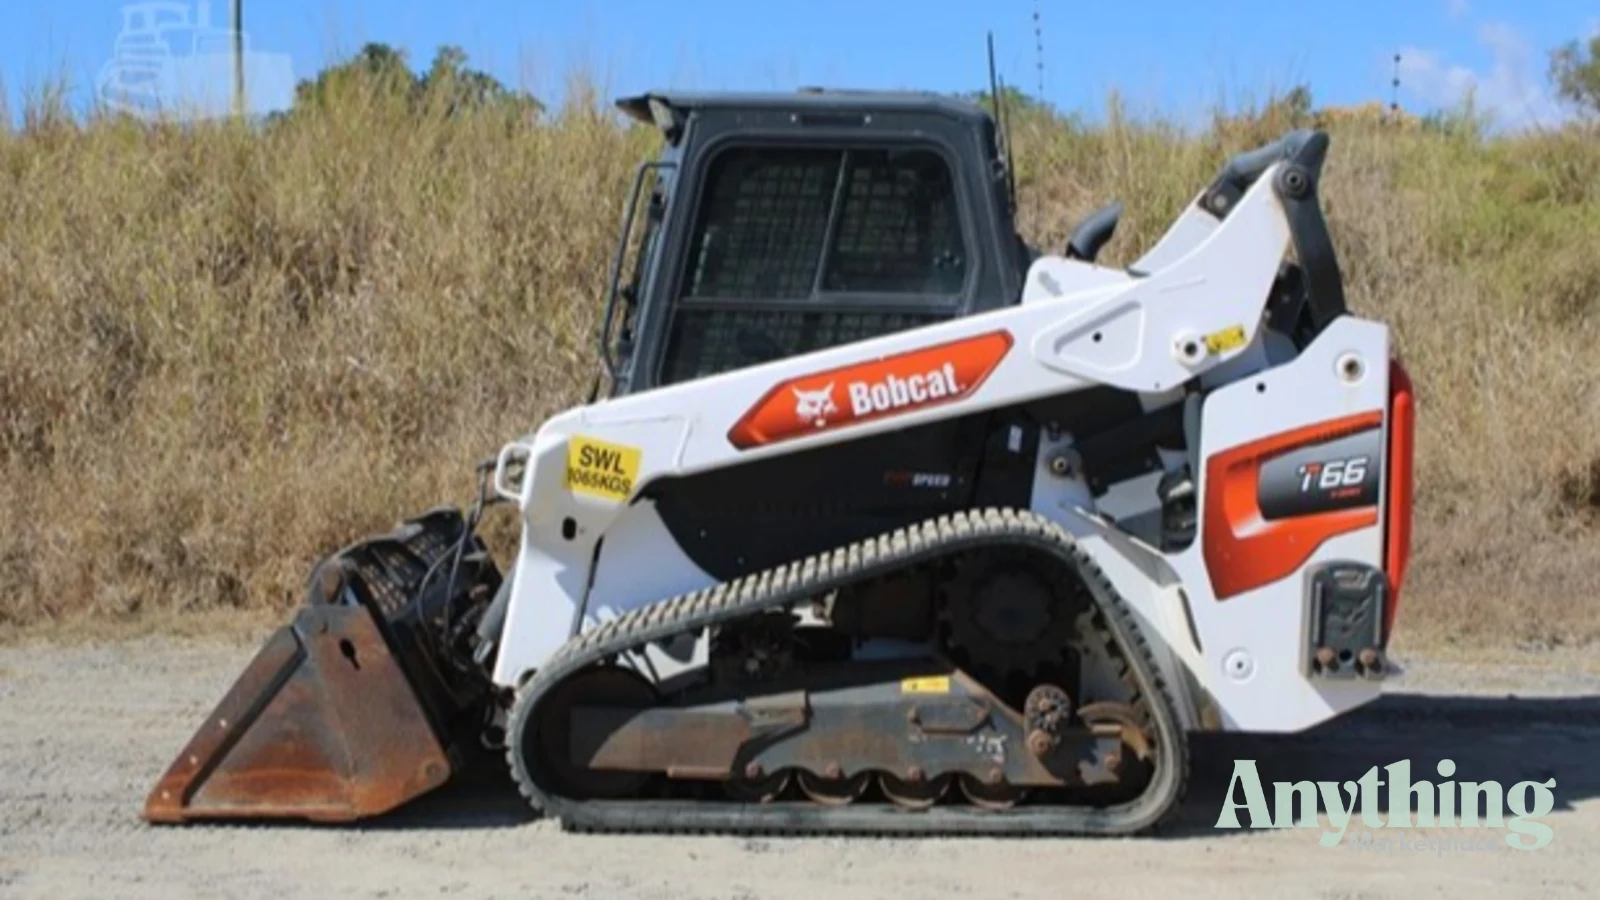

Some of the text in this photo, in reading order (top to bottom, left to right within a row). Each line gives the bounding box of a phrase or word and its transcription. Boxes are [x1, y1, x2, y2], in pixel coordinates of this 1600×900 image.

[848, 362, 960, 416] Bobcat
[579, 444, 626, 475] SWL
[1299, 458, 1368, 492] T66
